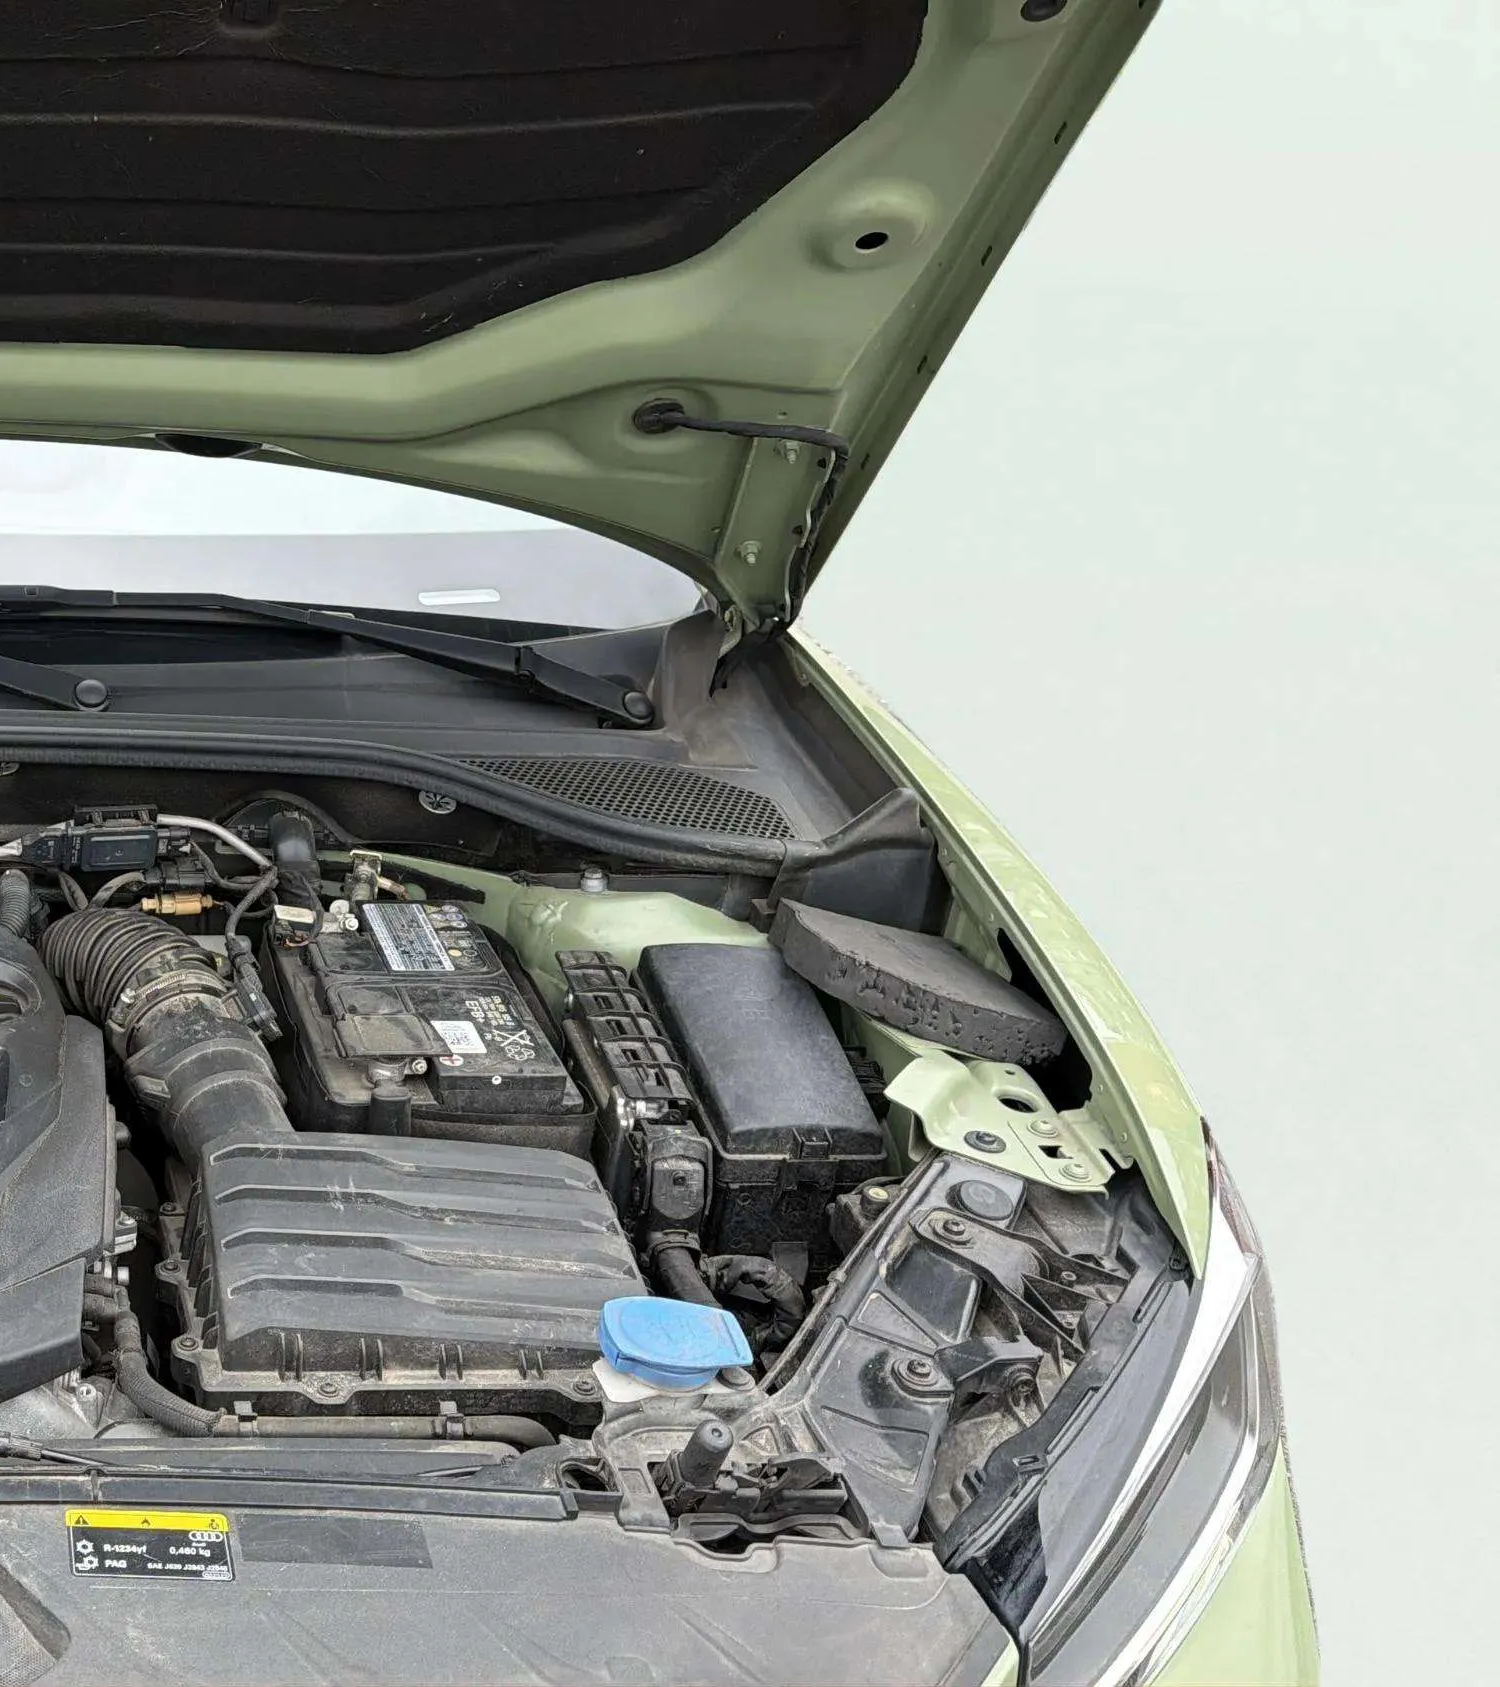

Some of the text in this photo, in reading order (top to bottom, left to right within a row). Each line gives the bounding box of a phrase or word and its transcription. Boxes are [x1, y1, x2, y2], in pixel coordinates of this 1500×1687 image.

[103, 1544, 147, 1554] R-1234yf
[198, 1548, 211, 1557] kg
[105, 1559, 127, 1568] PAG
[147, 1562, 163, 1570] SAE
